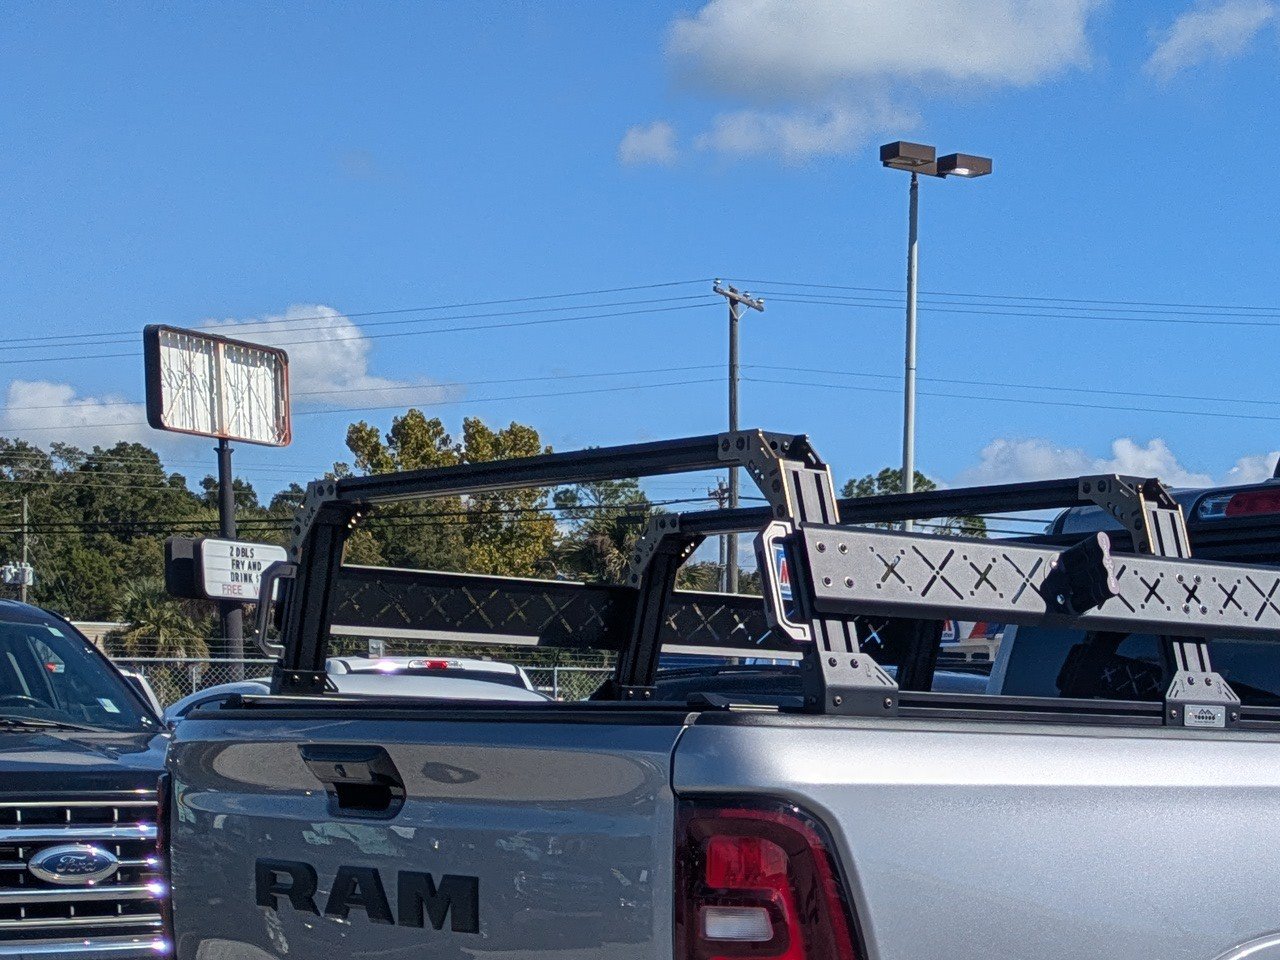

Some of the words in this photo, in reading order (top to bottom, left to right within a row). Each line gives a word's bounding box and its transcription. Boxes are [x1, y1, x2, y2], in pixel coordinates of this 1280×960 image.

[230, 546, 234, 557] 2
[235, 546, 255, 559] DBLS
[231, 559, 245, 570] FRY
[247, 560, 262, 571] AND
[230, 571, 253, 583] DRINK
[222, 584, 243, 595] FREE
[56, 855, 97, 873] Ford
[254, 857, 479, 934] RAM
